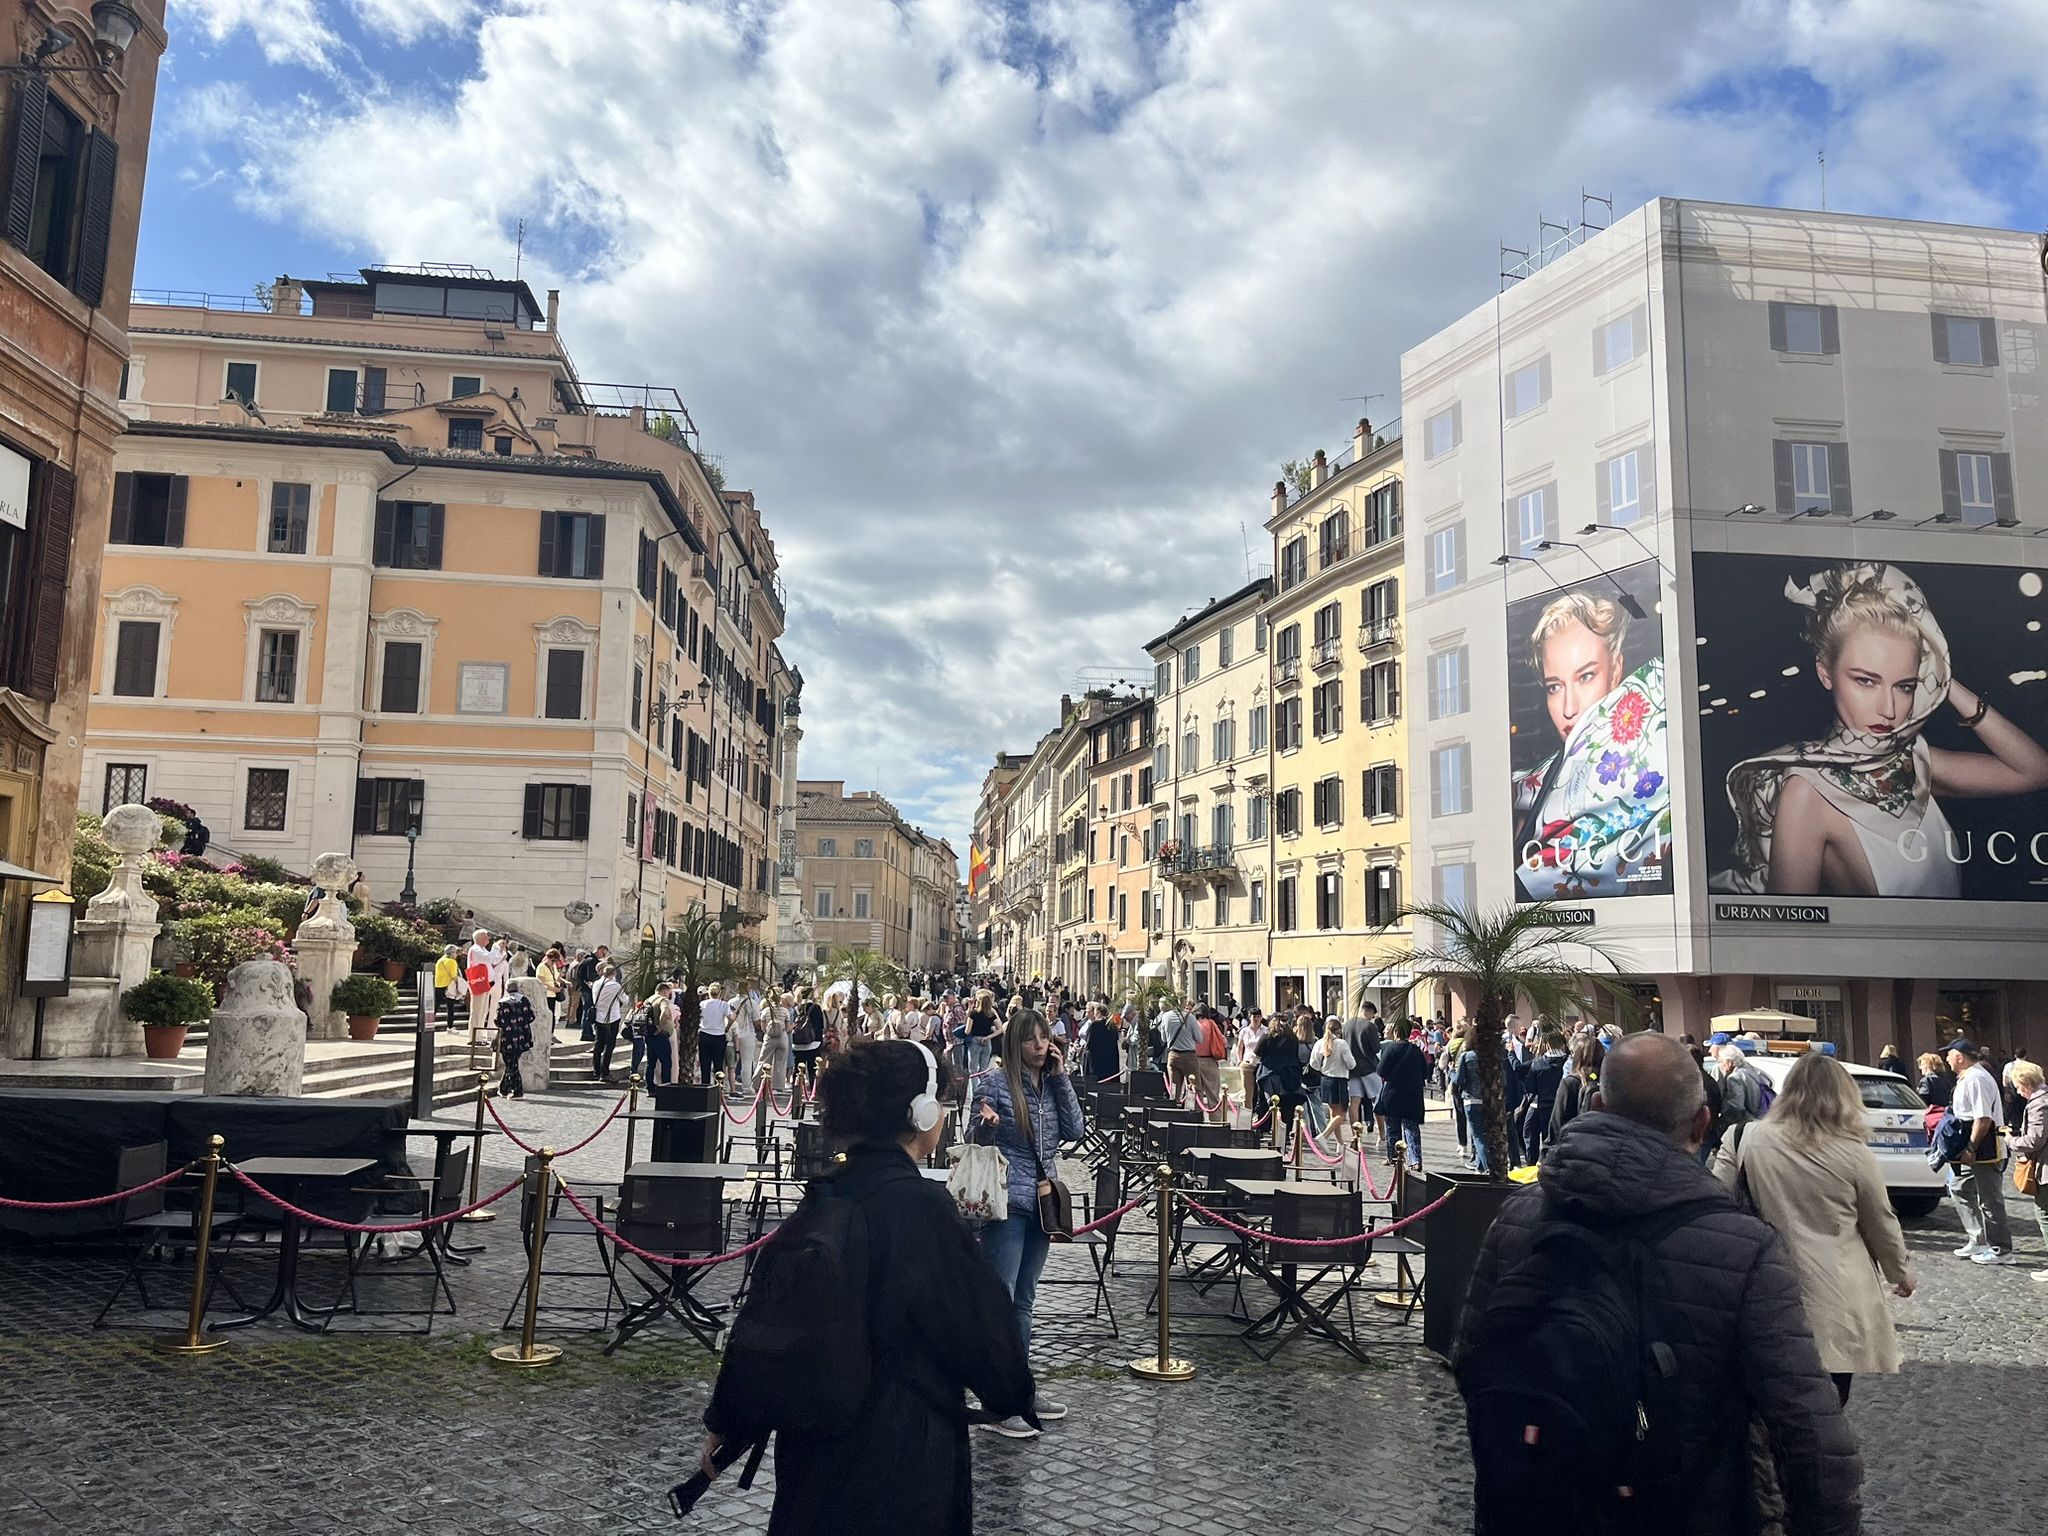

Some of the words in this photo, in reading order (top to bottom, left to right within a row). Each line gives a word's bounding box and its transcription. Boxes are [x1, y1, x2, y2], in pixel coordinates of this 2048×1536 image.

[1522, 828, 1662, 870] GUCCI
[1555, 911, 1591, 923] VISION
[1720, 906, 1771, 919] URBAN
[1775, 907, 1826, 920] VISION
[1793, 988, 1822, 998] DIOR
